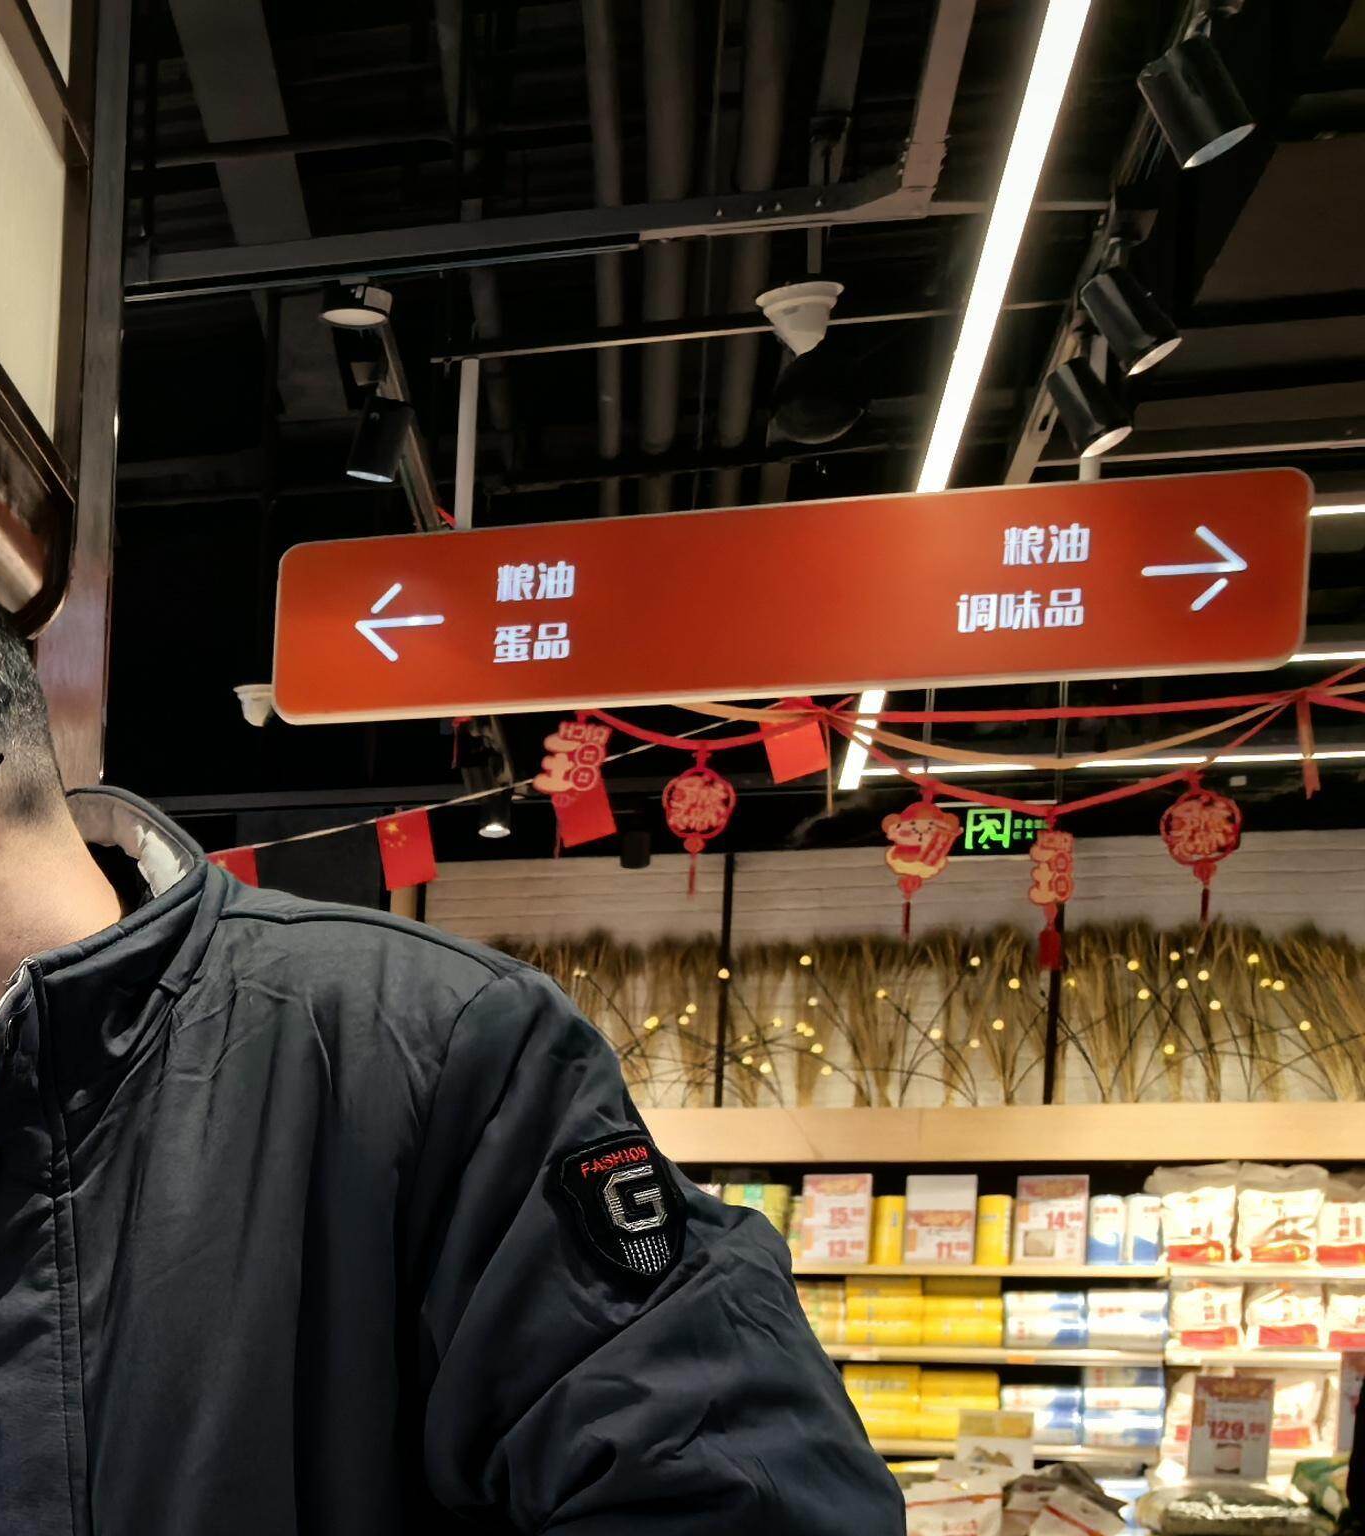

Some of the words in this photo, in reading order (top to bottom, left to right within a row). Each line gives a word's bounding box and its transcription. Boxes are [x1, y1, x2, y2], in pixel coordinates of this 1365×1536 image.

[1004, 525, 1088, 566] 粮油
[497, 562, 574, 602] 粮油
[957, 590, 1084, 633] 调味品
[493, 622, 571, 663] 蛋品
[580, 1145, 649, 1178] FASHION
[603, 1164, 668, 1233] G
